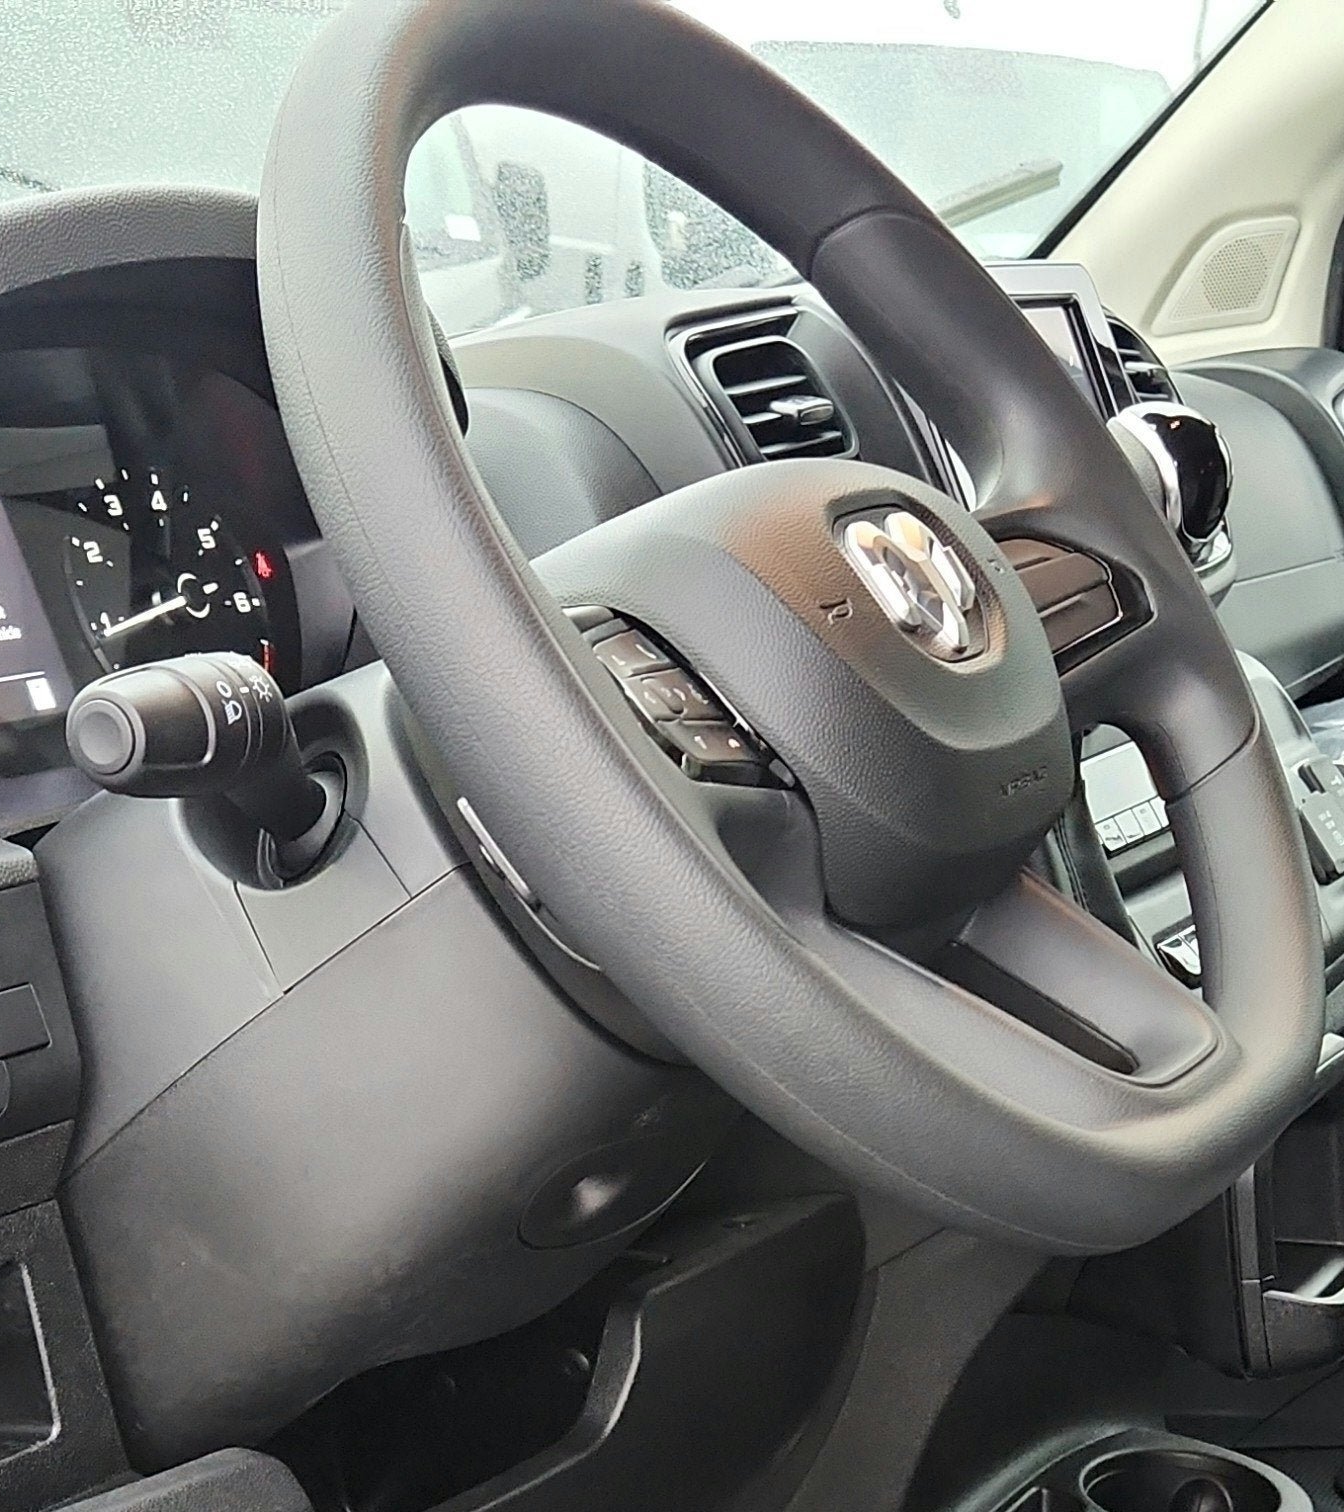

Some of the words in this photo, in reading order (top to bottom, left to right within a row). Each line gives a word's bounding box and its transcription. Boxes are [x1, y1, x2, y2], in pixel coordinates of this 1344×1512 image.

[104, 494, 123, 516] 3
[151, 490, 167, 511] 4
[197, 528, 216, 549] 5
[83, 541, 103, 563] 2
[233, 592, 252, 613] 6
